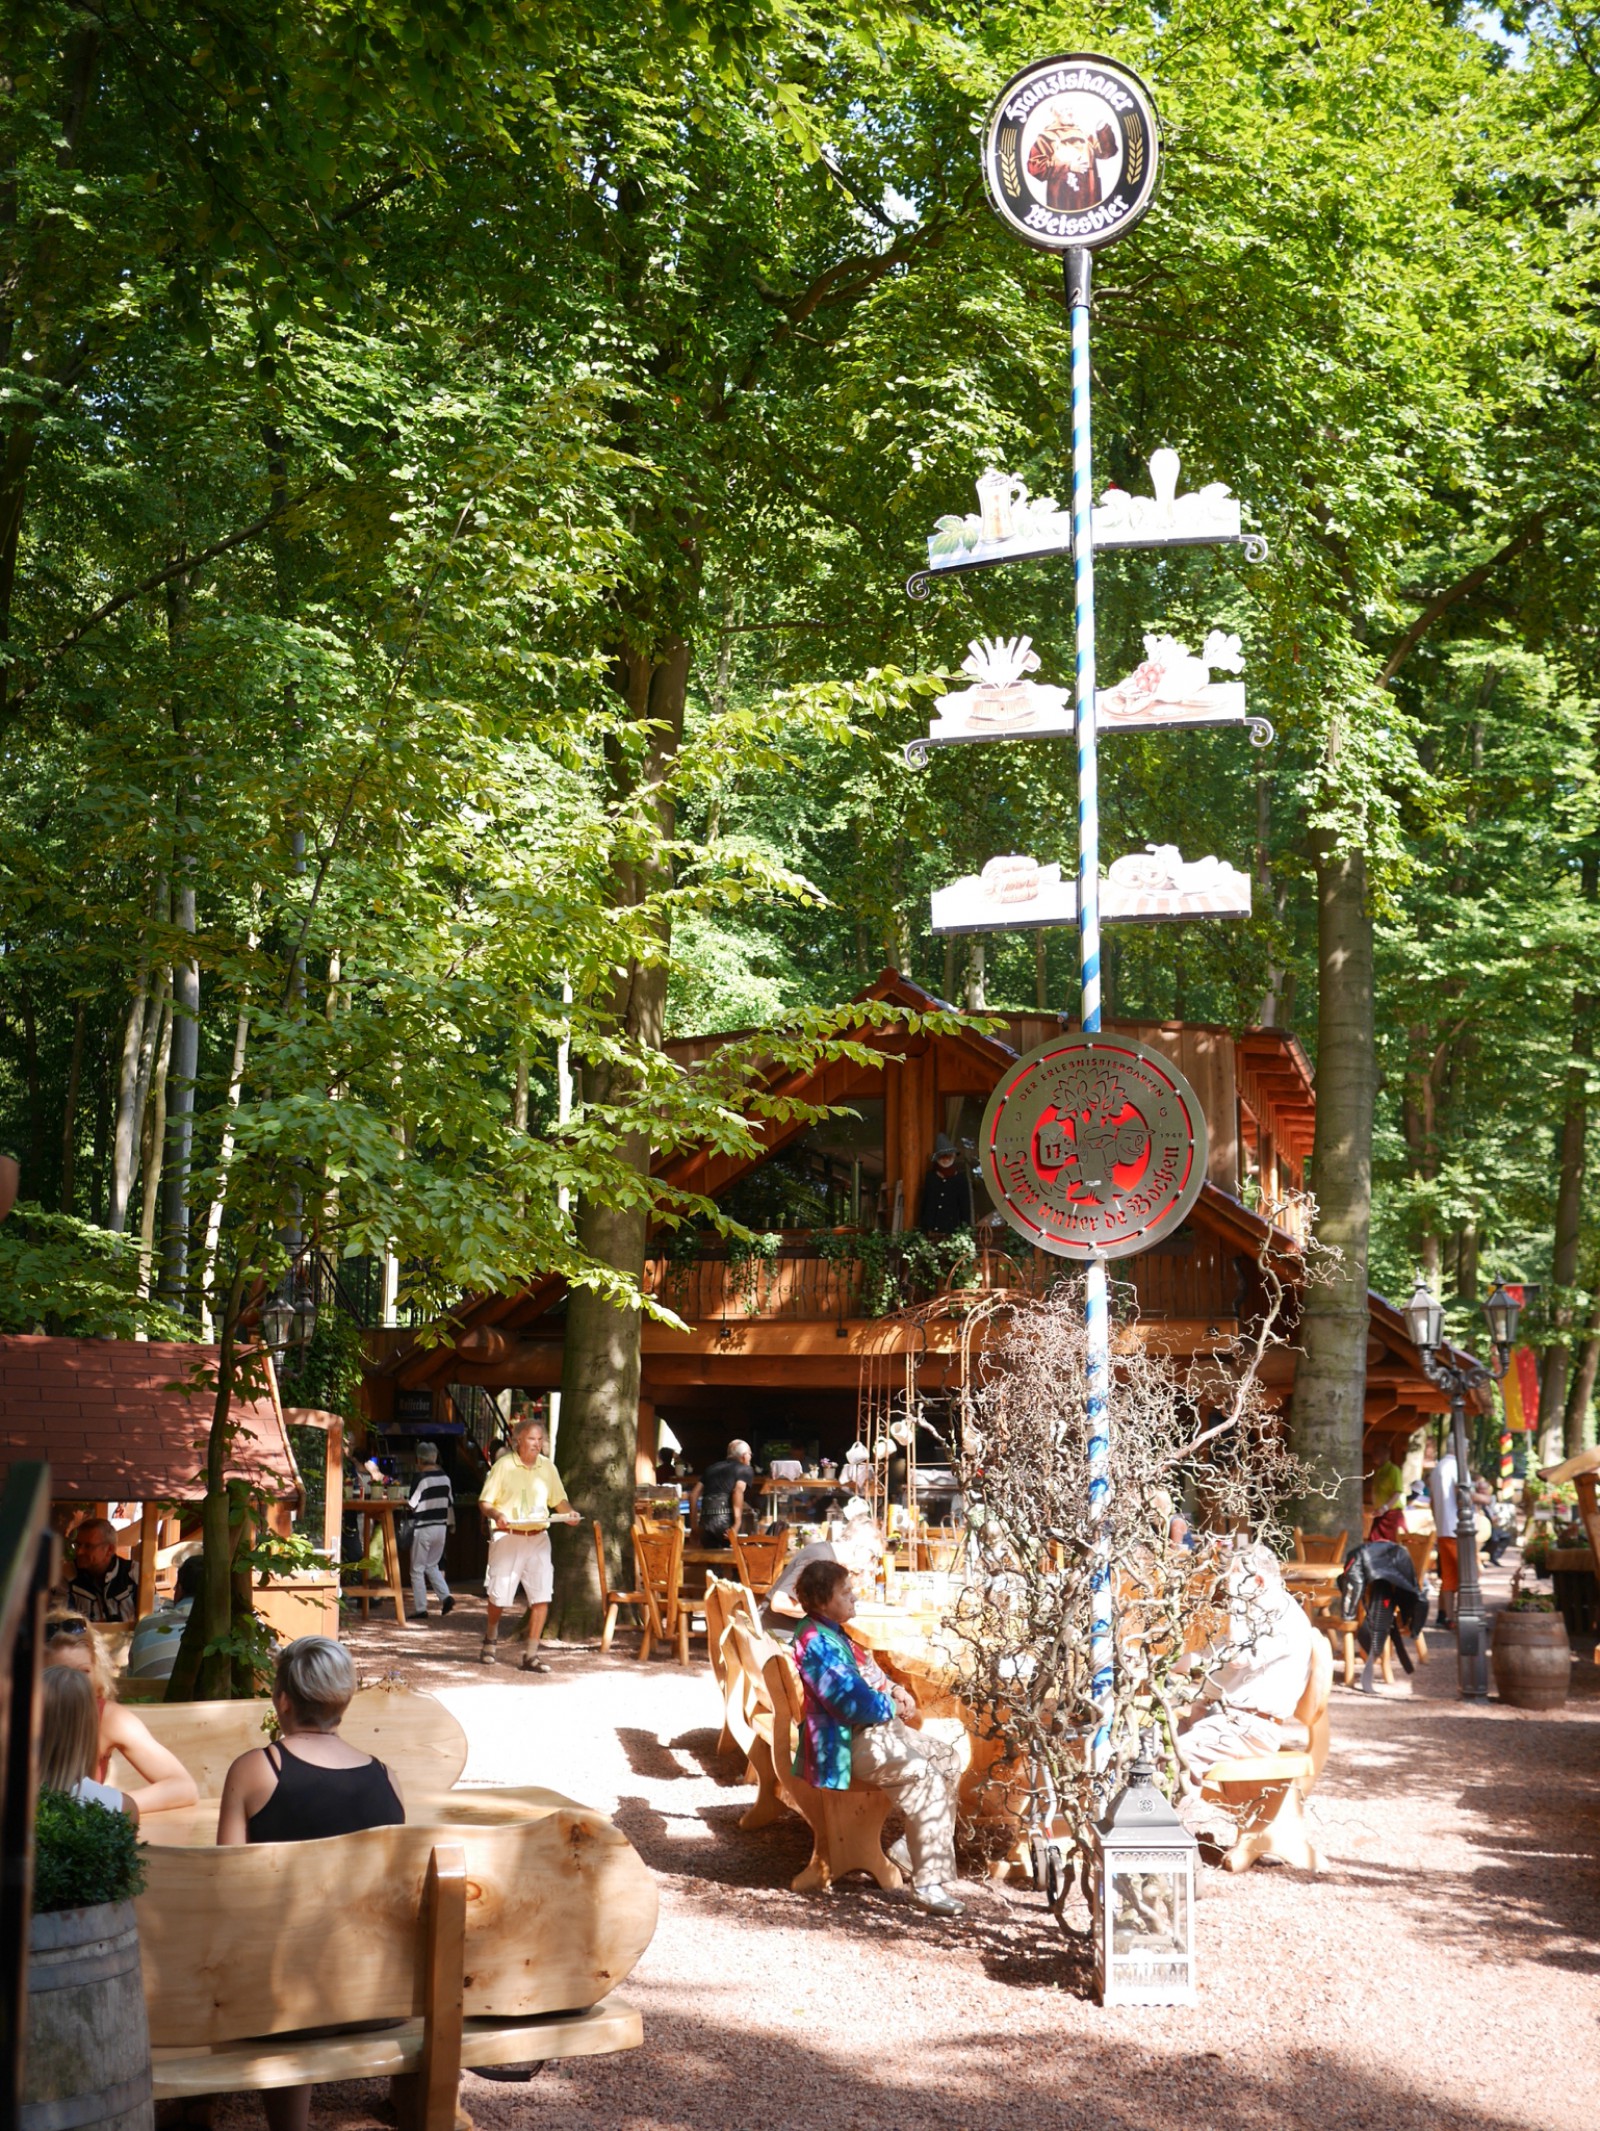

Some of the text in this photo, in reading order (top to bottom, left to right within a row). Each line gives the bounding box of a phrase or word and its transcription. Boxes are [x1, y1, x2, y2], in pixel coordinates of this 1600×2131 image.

[1004, 69, 1134, 123] Franziskaner
[1023, 195, 1130, 236] Weissbier
[1019, 1058, 1165, 1102] DER ERLEBNISBIERGARTEN
[1037, 1200, 1099, 1232] unner
[1104, 1209, 1128, 1230] de
